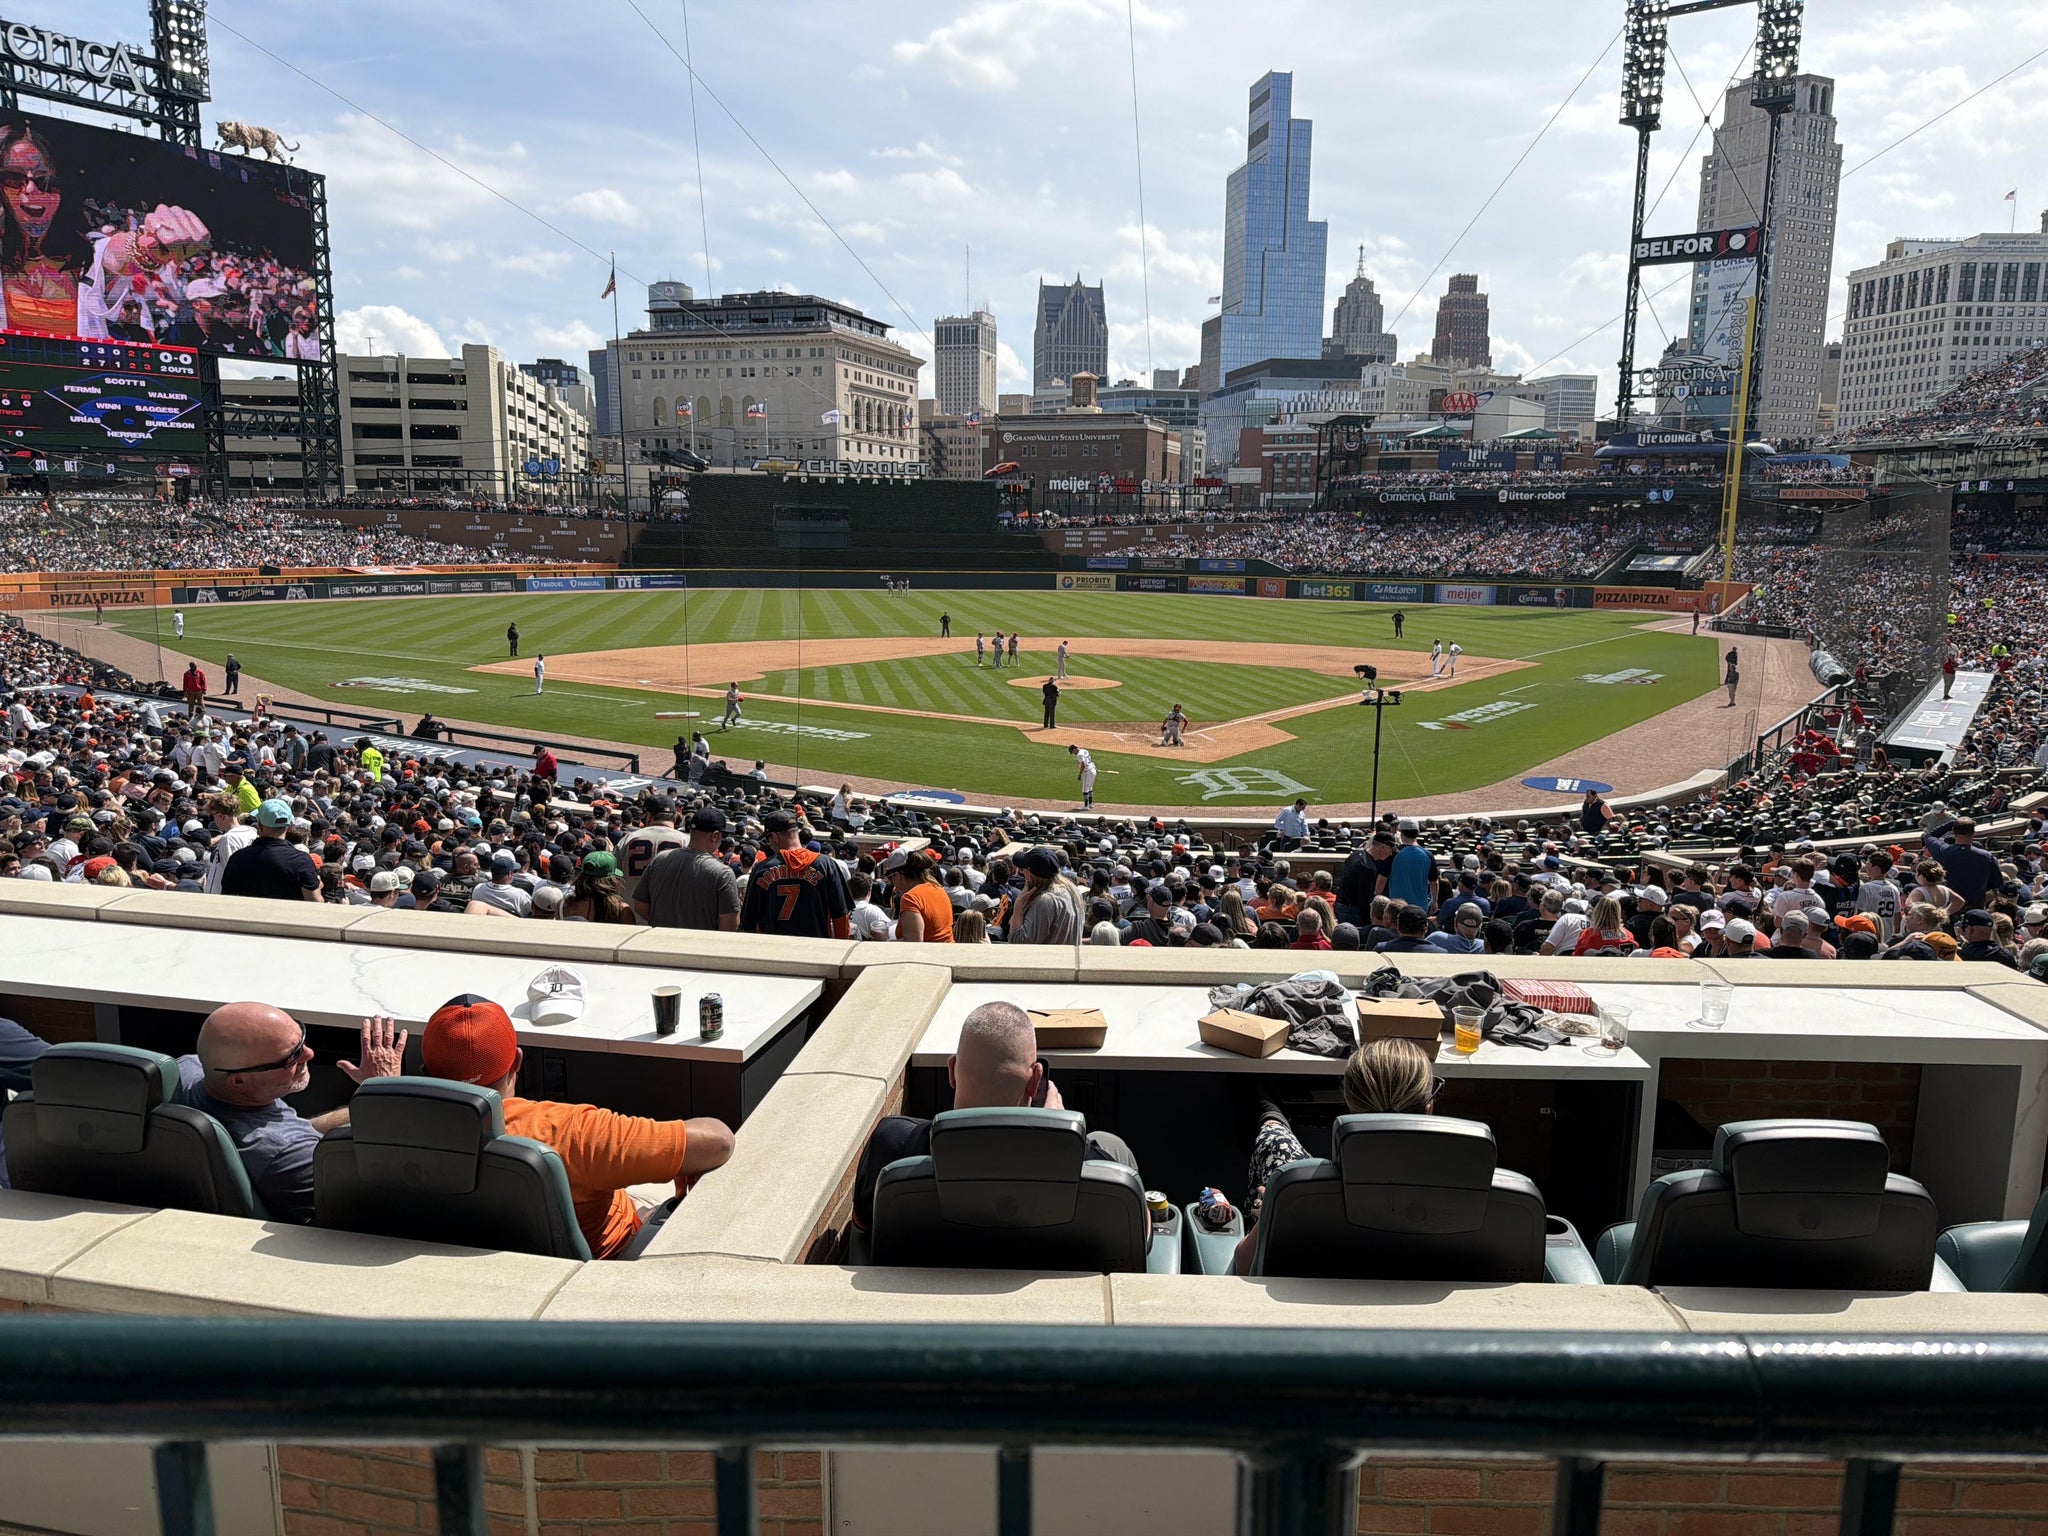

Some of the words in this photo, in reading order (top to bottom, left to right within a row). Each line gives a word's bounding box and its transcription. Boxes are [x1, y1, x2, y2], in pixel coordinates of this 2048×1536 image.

[0, 23, 149, 97] ericA
[1636, 237, 1714, 258] BELFOR
[159, 352, 193, 365] 0-0
[82, 358, 90, 366] 2
[168, 366, 194, 375] OUTS
[104, 377, 139, 386] SCOTT
[148, 391, 188, 400] WALKER
[1639, 386, 1727, 399] LANDING
[96, 402, 122, 411] WINN
[135, 404, 180, 414] SAGGESE
[145, 420, 195, 429] BURLESON
[107, 430, 153, 439] HERRERA
[1658, 434, 1697, 444] LOUNGE
[1468, 448, 1489, 463] Lite
[35, 459, 49, 472] STL
[64, 461, 79, 472] DET
[806, 459, 930, 476] CHEVROLET
[782, 476, 912, 486] FOUNTAIN
[1049, 476, 1091, 494] meijer
[1204, 487, 1223, 495] LAW
[1429, 491, 1456, 501] Bank
[387, 514, 398, 522] 23
[517, 518, 524, 526] 2
[560, 520, 568, 528] 16
[603, 524, 610, 532] 6
[1205, 525, 1215, 533] 42
[494, 533, 505, 541] 47
[1145, 528, 1154, 536] 10
[539, 535, 545, 543] 3
[576, 580, 601, 588] FANDUEL
[618, 577, 642, 588] DTE
[339, 586, 377, 595] BETMGM
[387, 584, 424, 593] BETMGM
[1303, 583, 1350, 597] bet365
[1383, 585, 1417, 594] McLaren
[1447, 586, 1483, 602] meijer
[1518, 593, 1547, 604] Corona
[777, 884, 801, 921] 7
[1878, 901, 1895, 918] 29
